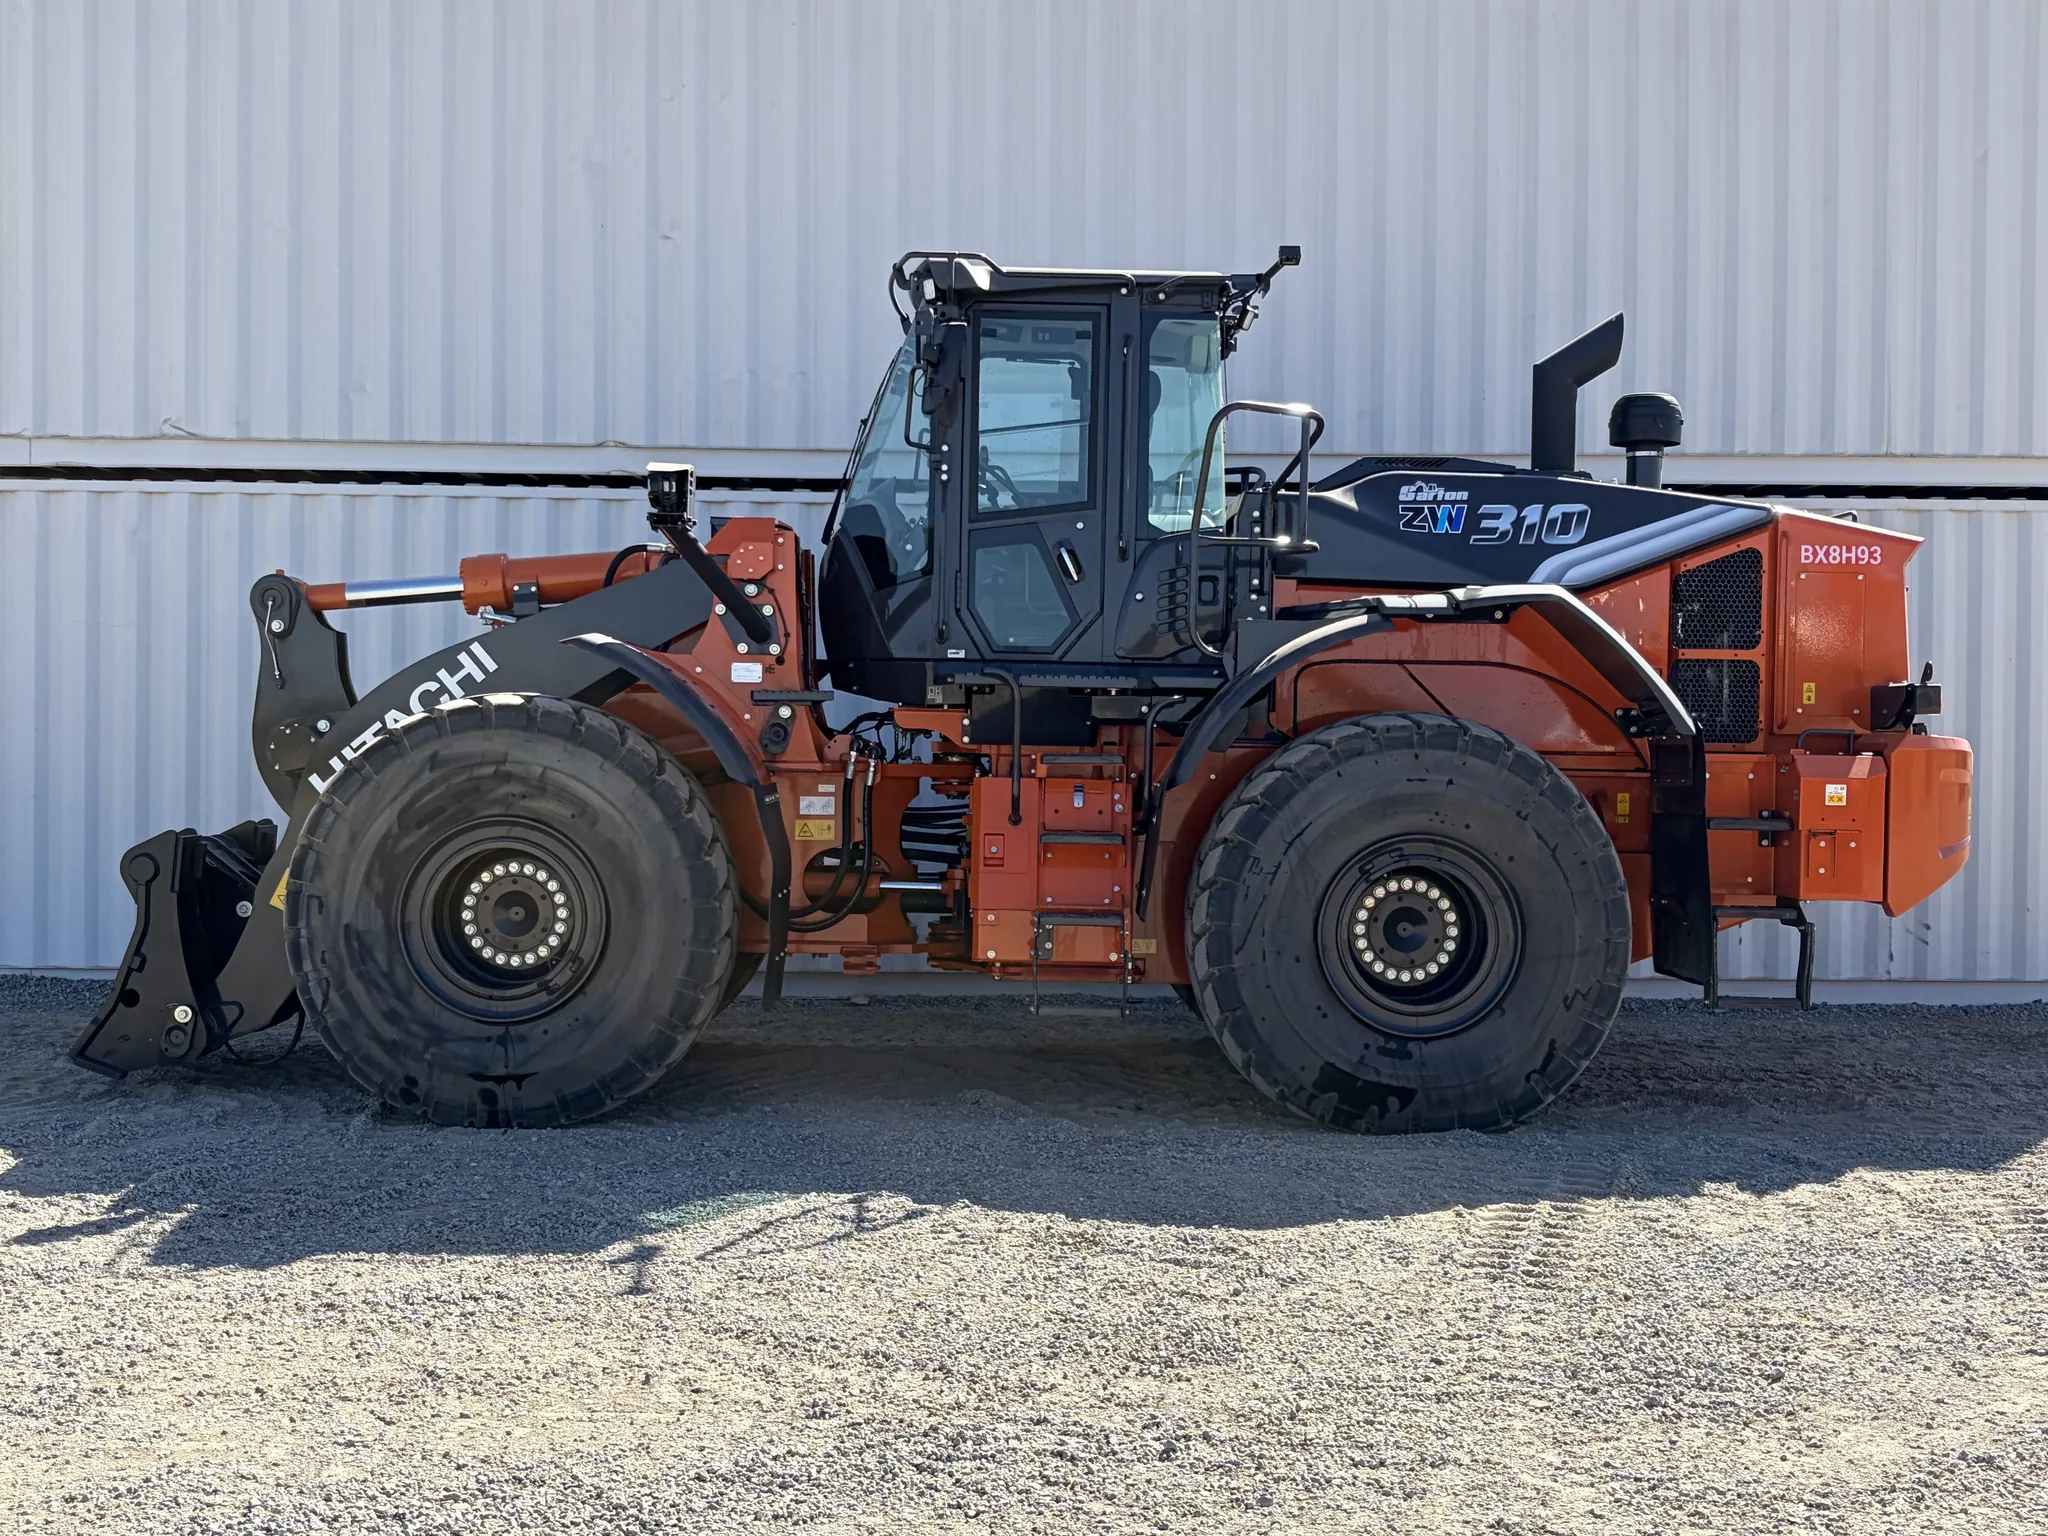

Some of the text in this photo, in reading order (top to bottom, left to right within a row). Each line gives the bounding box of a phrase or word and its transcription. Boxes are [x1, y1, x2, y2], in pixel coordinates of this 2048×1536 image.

[1399, 504, 1591, 544] ZW 310
[1800, 544, 1882, 565] BX8H93
